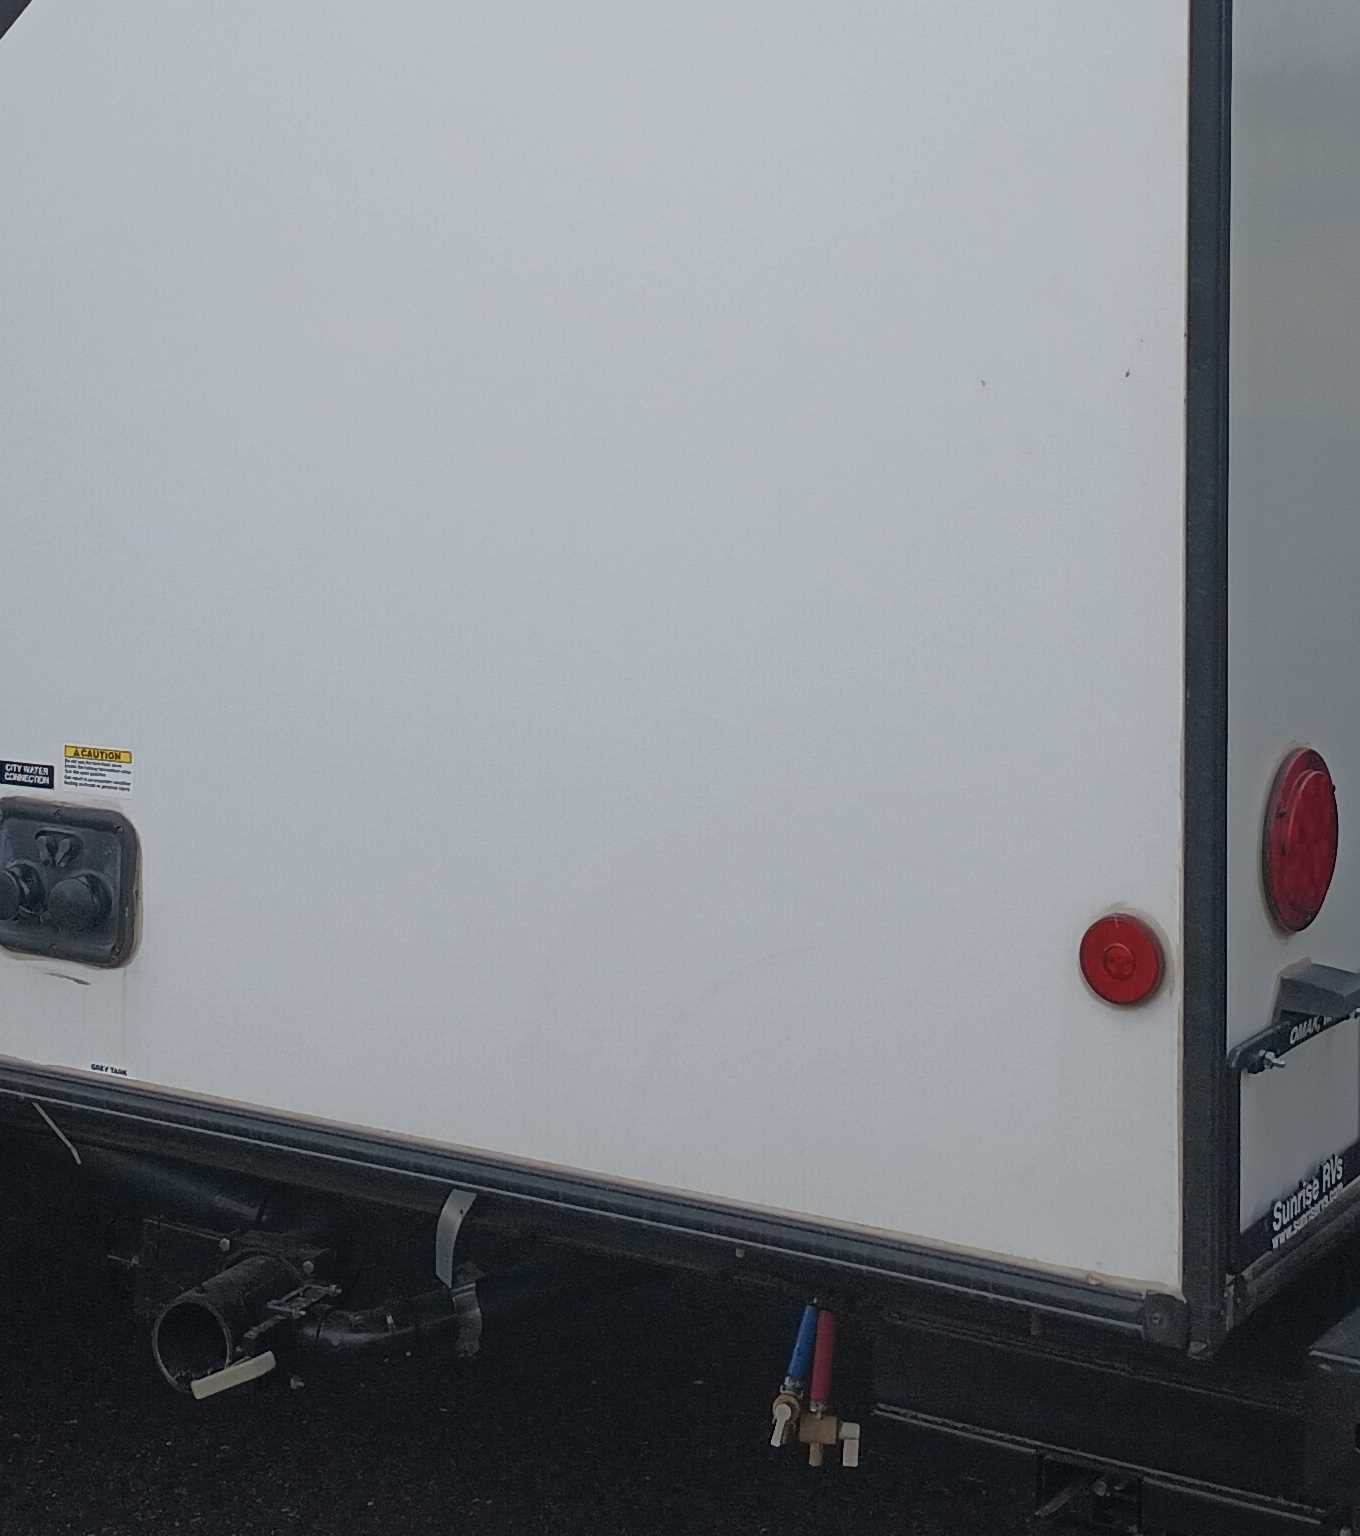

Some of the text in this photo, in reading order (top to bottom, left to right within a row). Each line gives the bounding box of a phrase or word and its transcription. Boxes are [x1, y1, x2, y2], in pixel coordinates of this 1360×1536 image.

[81, 749, 121, 761] CAUTION
[4, 764, 49, 776] CITY WATER
[4, 772, 50, 784] CONNECTION
[1272, 1156, 1343, 1232] Sunrise RVs
